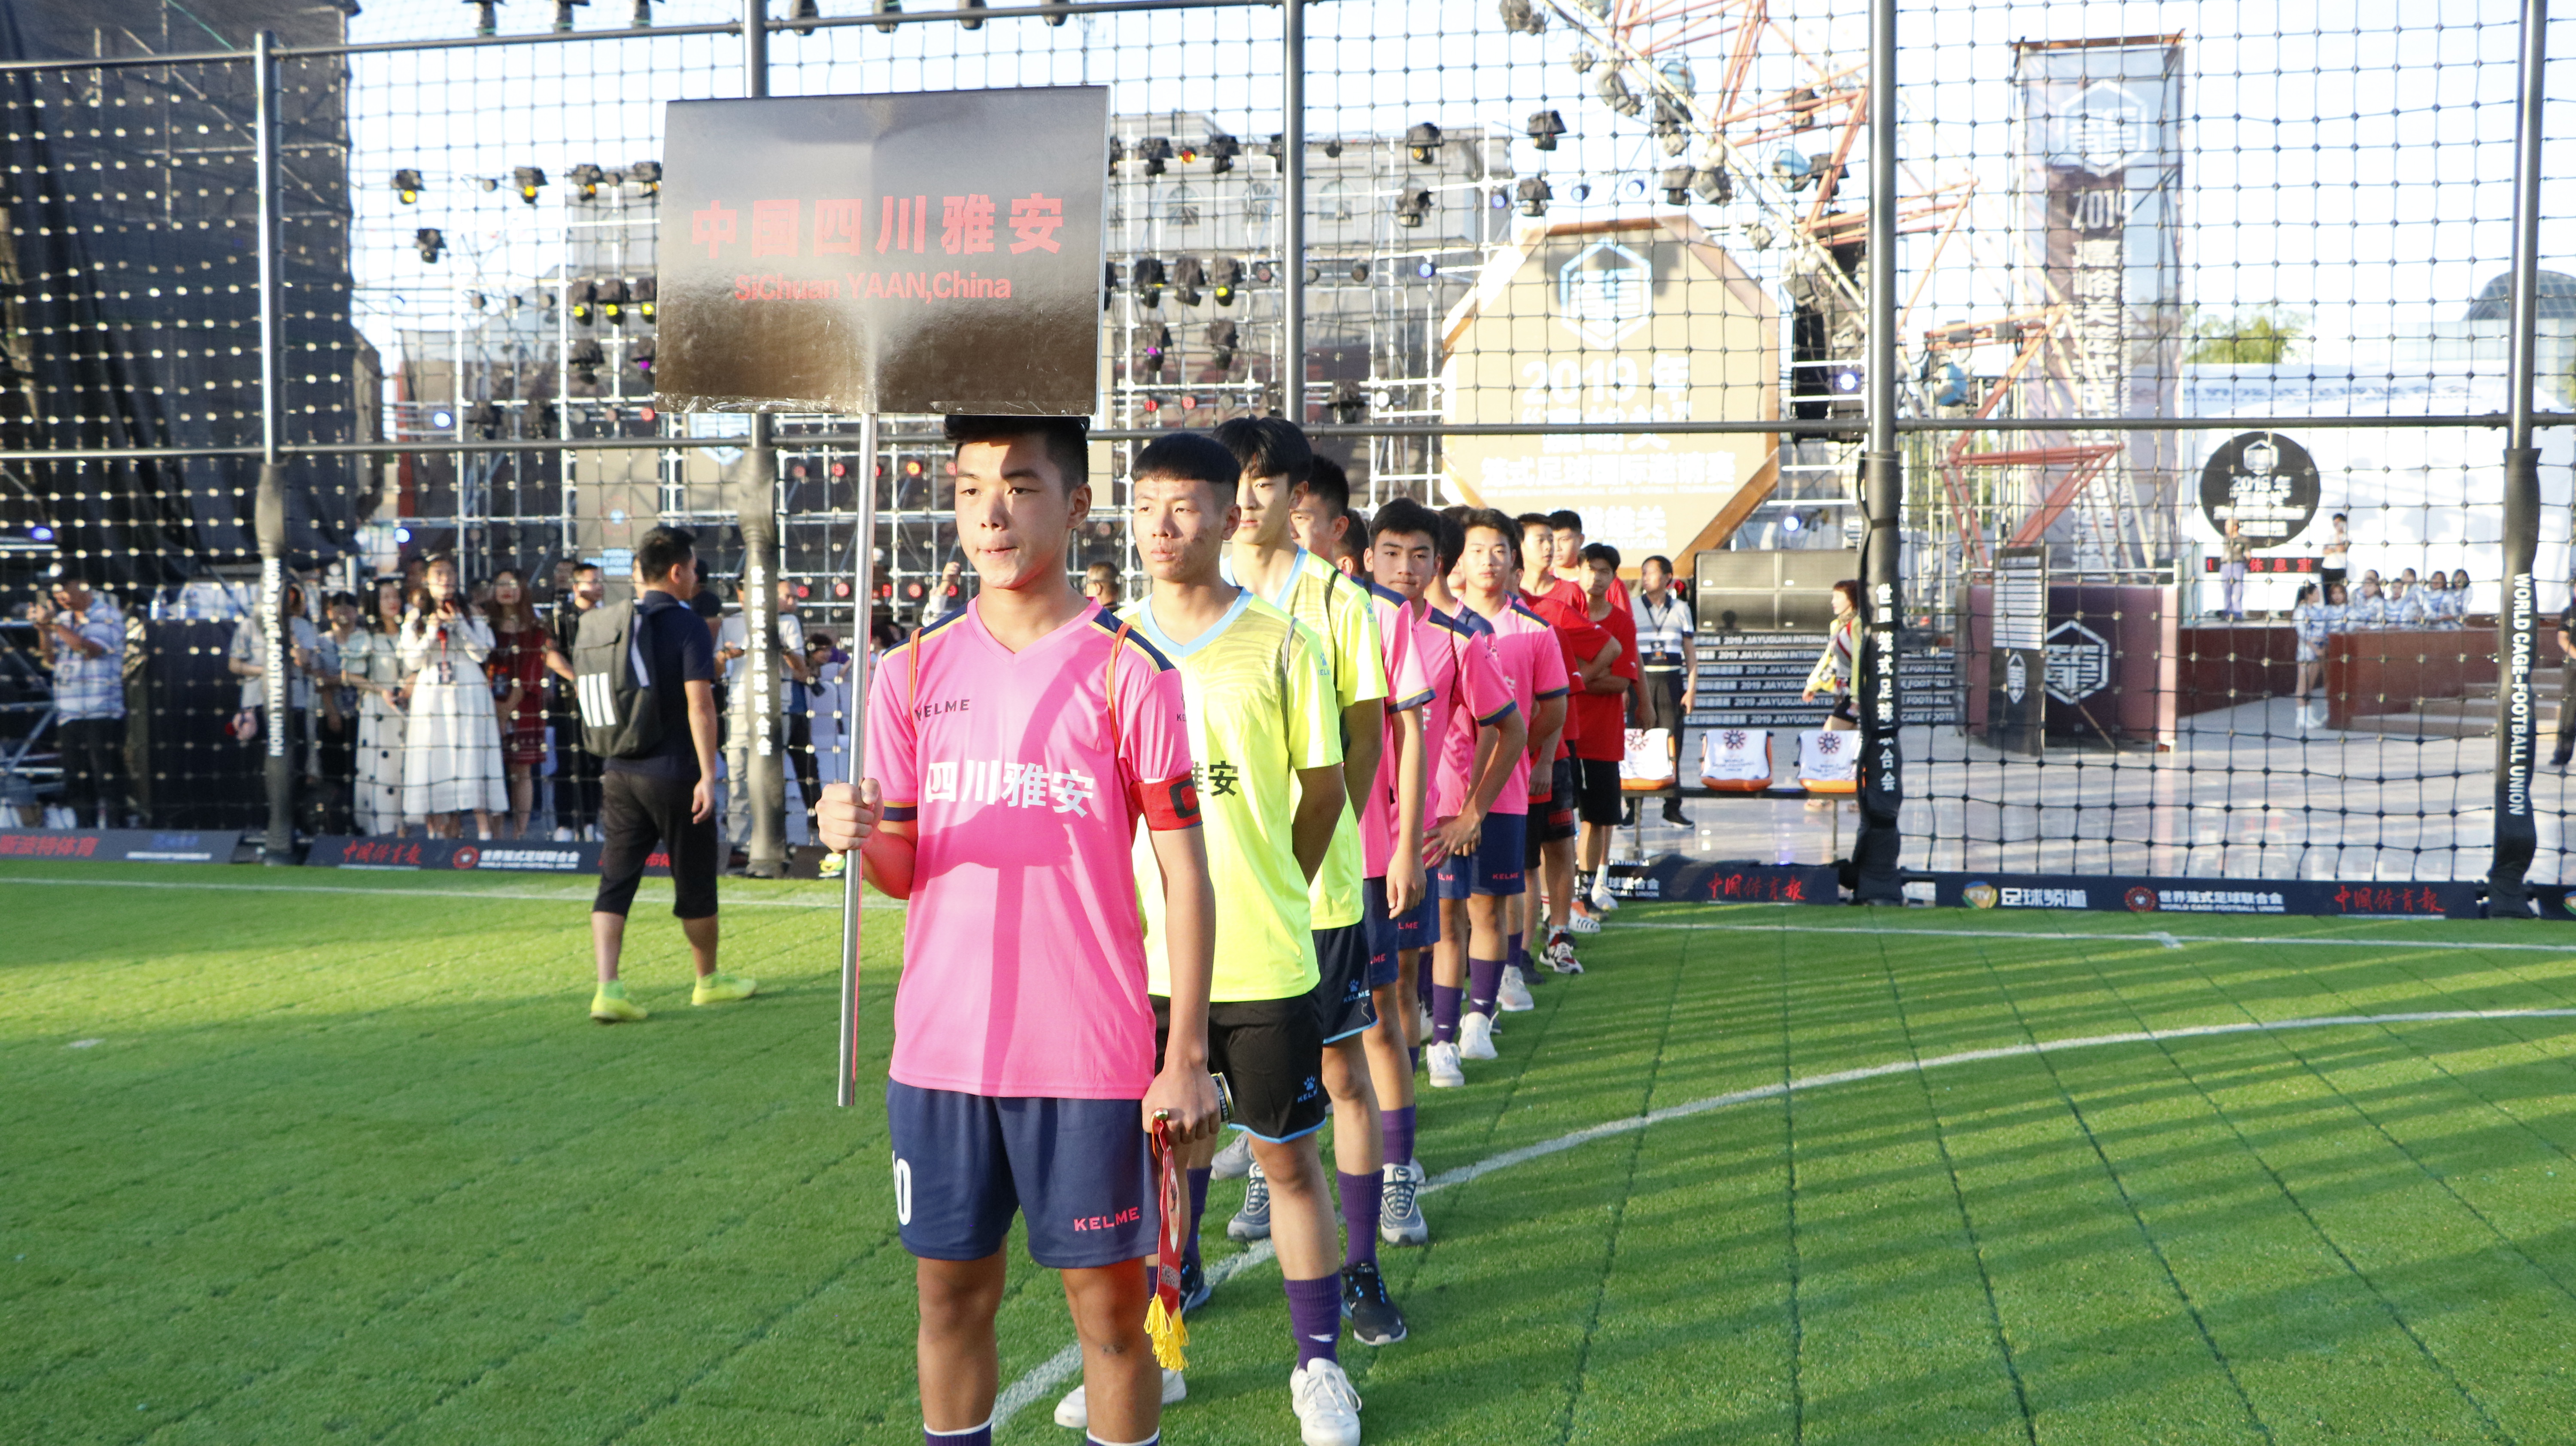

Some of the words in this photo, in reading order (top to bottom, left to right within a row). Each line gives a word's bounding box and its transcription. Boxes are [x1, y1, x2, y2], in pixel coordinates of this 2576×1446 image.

[692, 193, 1063, 258] 中国四川雅安
[735, 273, 839, 300] SiChuan
[846, 270, 1012, 304] YAAN,China
[1522, 357, 1638, 404] 2019
[2513, 573, 2531, 630] WORLD
[2510, 632, 2531, 763] CAGE-FOOTBALL
[268, 712, 284, 756] UNION
[925, 759, 1094, 817] 四川雅安
[2509, 767, 2525, 815] UNION
[2001, 887, 2088, 908] 足球频道
[1398, 921, 1419, 930] LME
[1343, 989, 1370, 1003] KELME
[1073, 1207, 1140, 1231] KELME
